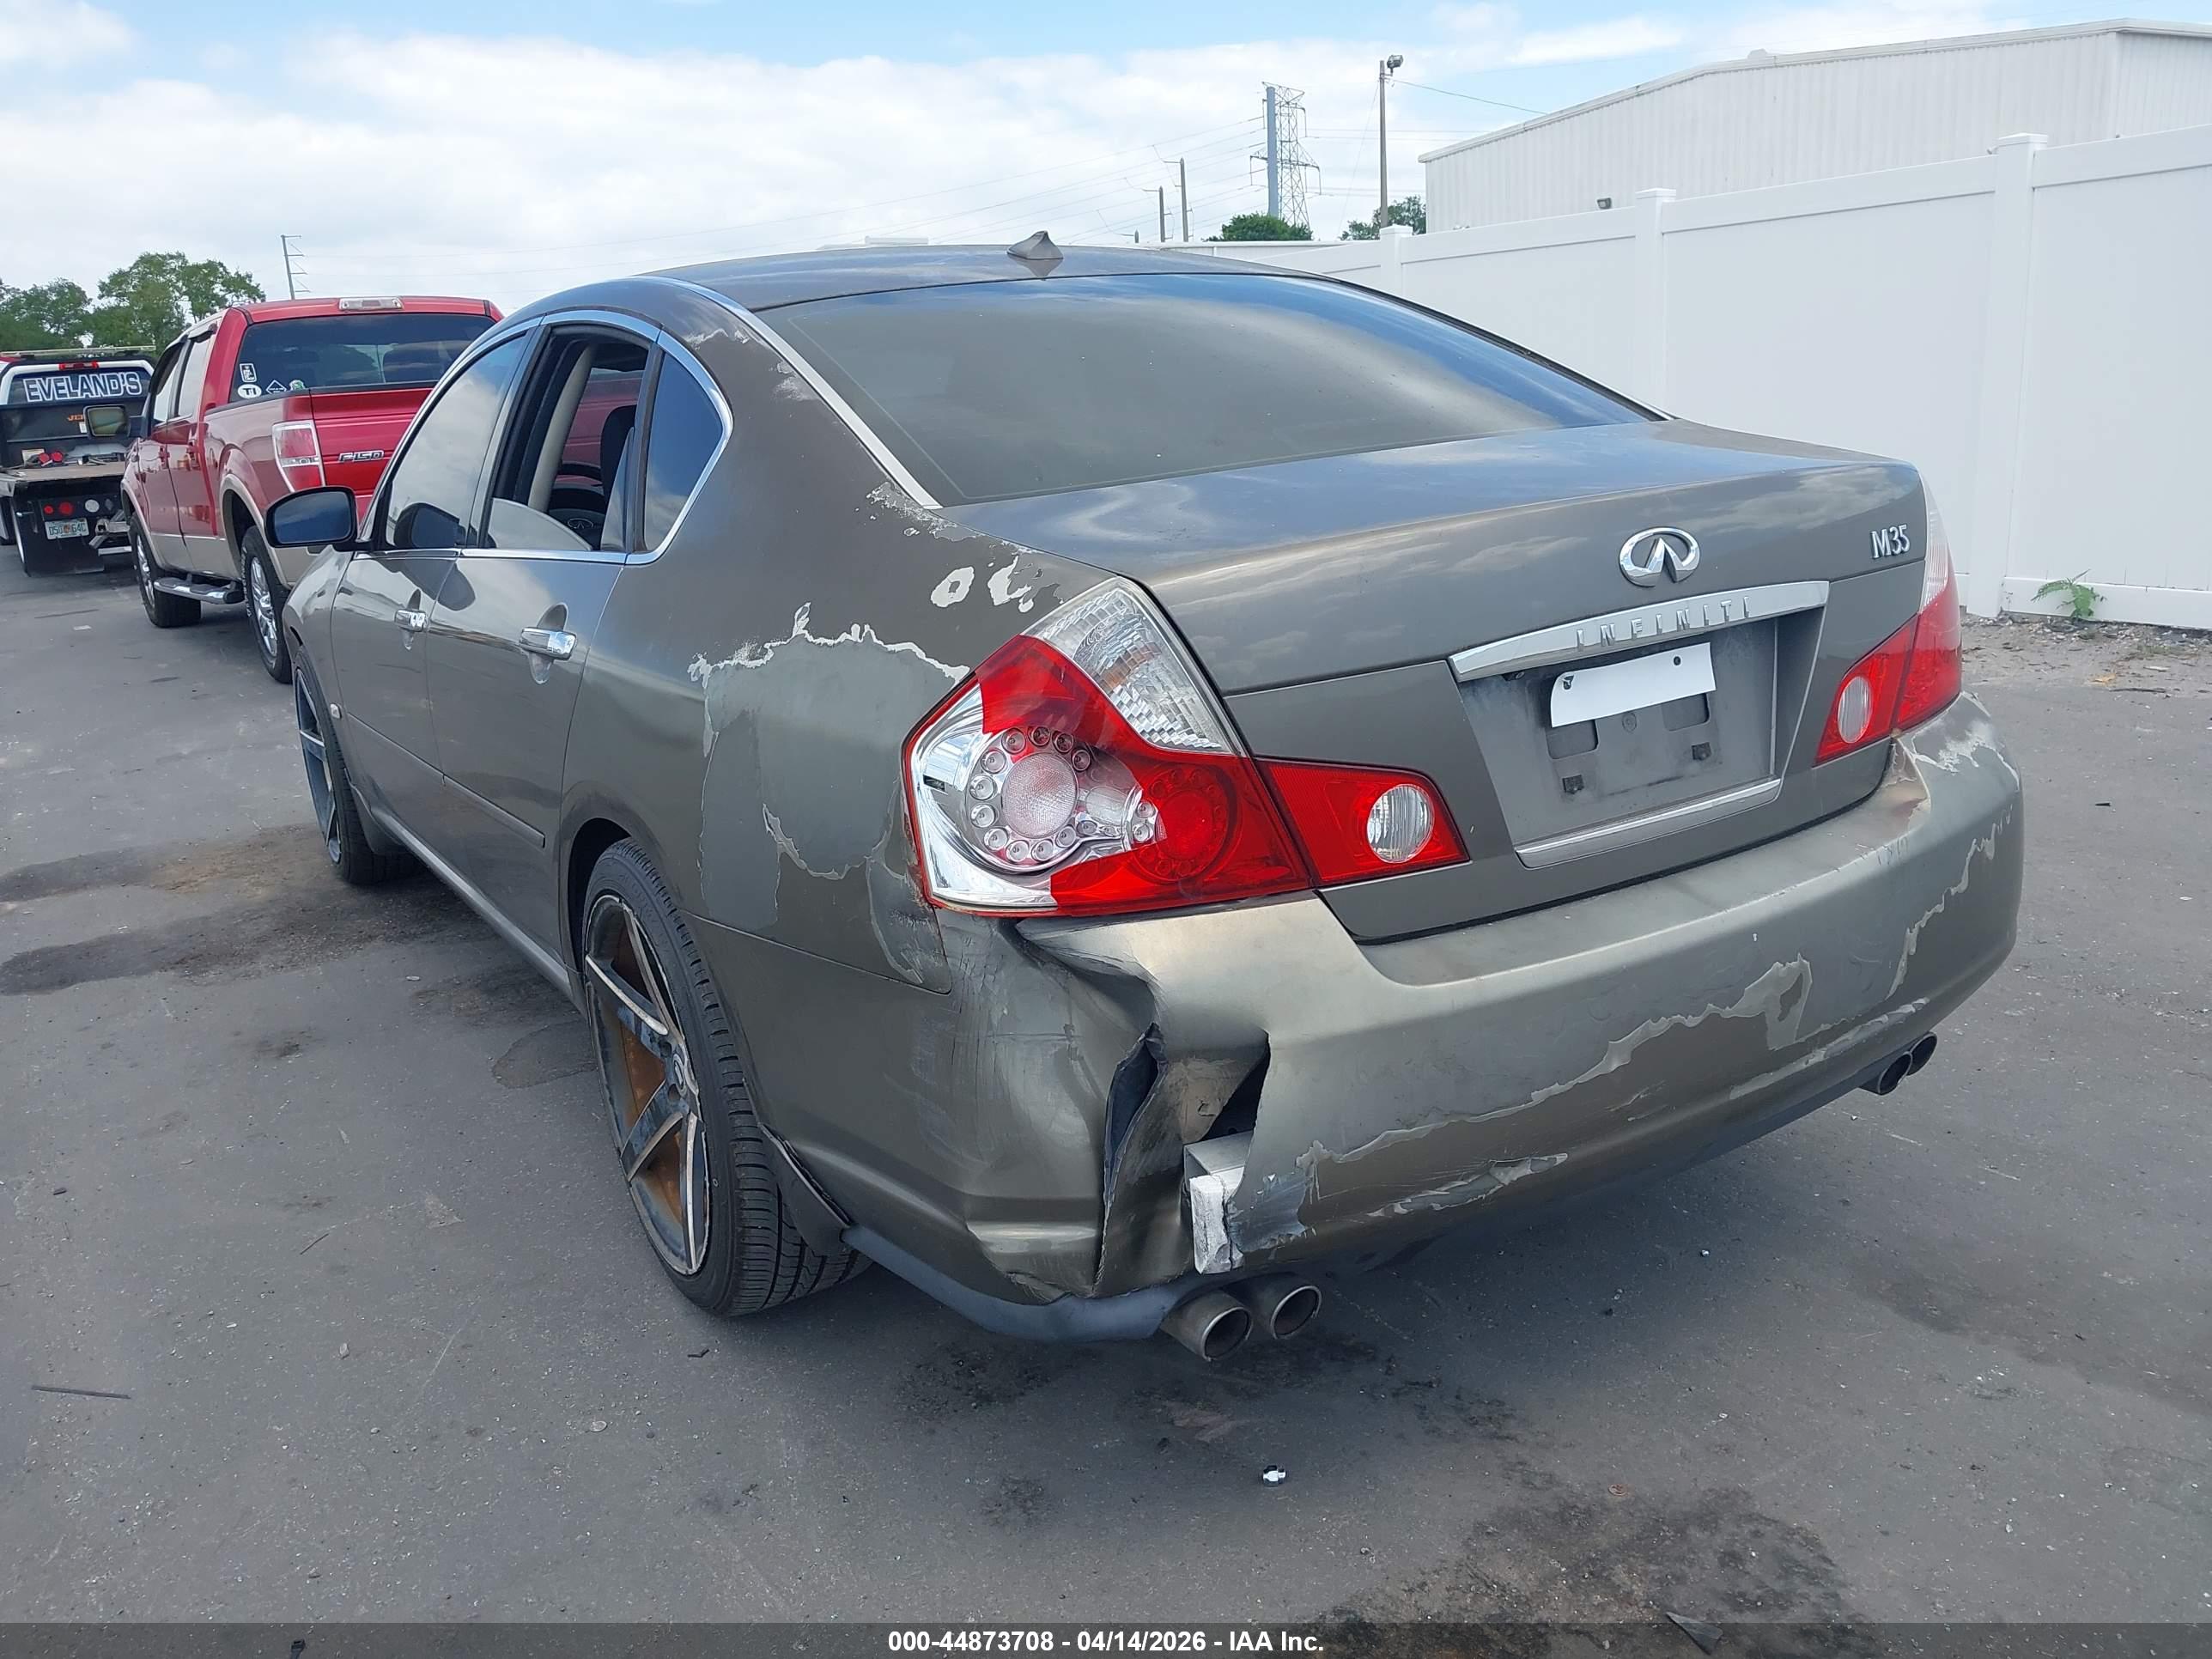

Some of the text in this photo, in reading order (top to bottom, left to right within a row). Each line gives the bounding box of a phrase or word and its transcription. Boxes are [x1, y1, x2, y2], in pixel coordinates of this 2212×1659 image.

[23, 372, 142, 402] EVELAND'S
[338, 450, 385, 462] F-150
[1870, 523, 1911, 559] M35
[1577, 596, 1752, 652] INFINITI
